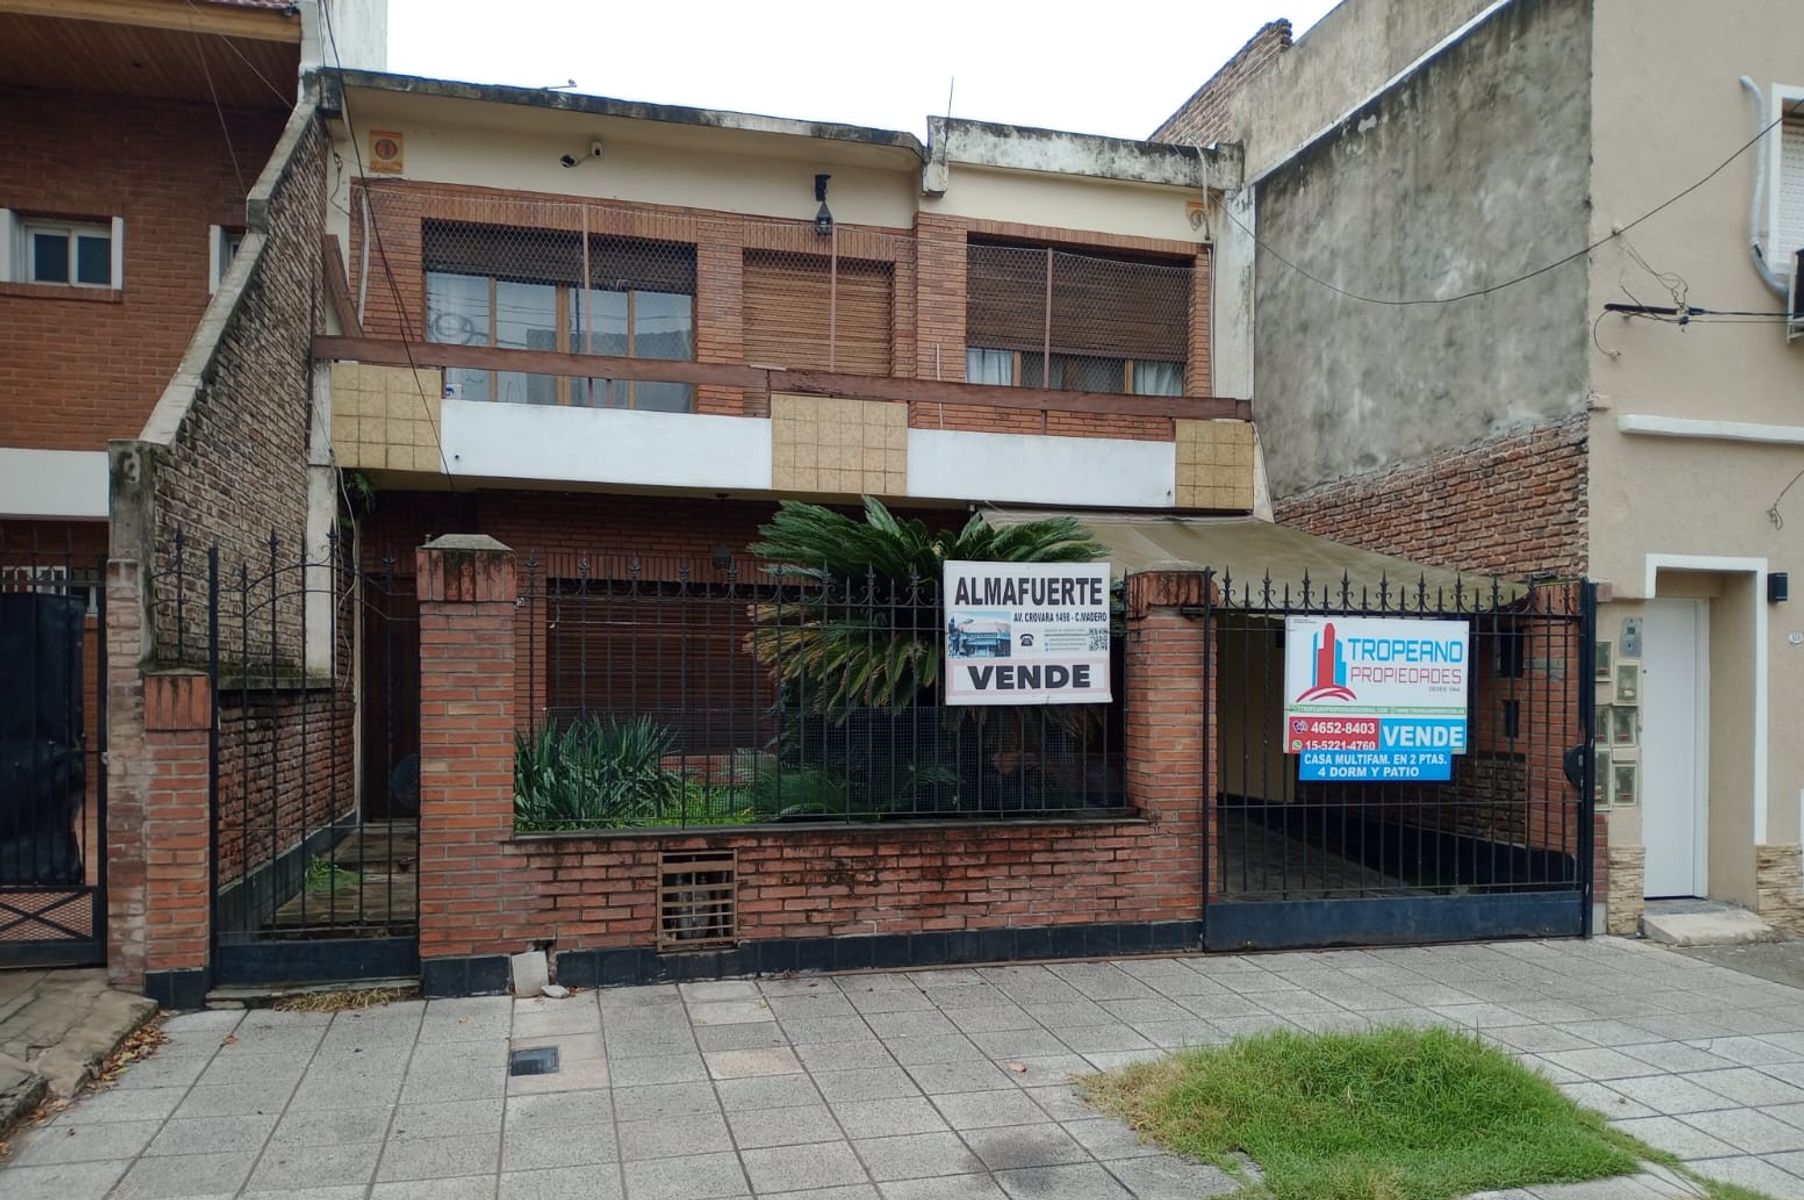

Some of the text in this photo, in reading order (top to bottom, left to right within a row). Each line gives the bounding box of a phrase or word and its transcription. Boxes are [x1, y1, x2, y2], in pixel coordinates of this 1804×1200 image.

[954, 577, 1103, 606] ALMAFUERTE
[1025, 612, 1054, 623] CROVARA
[1075, 611, 1108, 622] C.MADERO
[1347, 638, 1463, 663] TROPEANO
[967, 664, 1091, 690] VENDE
[1350, 666, 1462, 684] PROPIEDADES
[1310, 721, 1375, 734] 4652-8403
[1382, 726, 1464, 748] VENDE
[1304, 753, 1448, 765] CASA MULTIFAM. EN 2 PTAS.
[1317, 766, 1420, 777] 4 DORM Y PATIO
